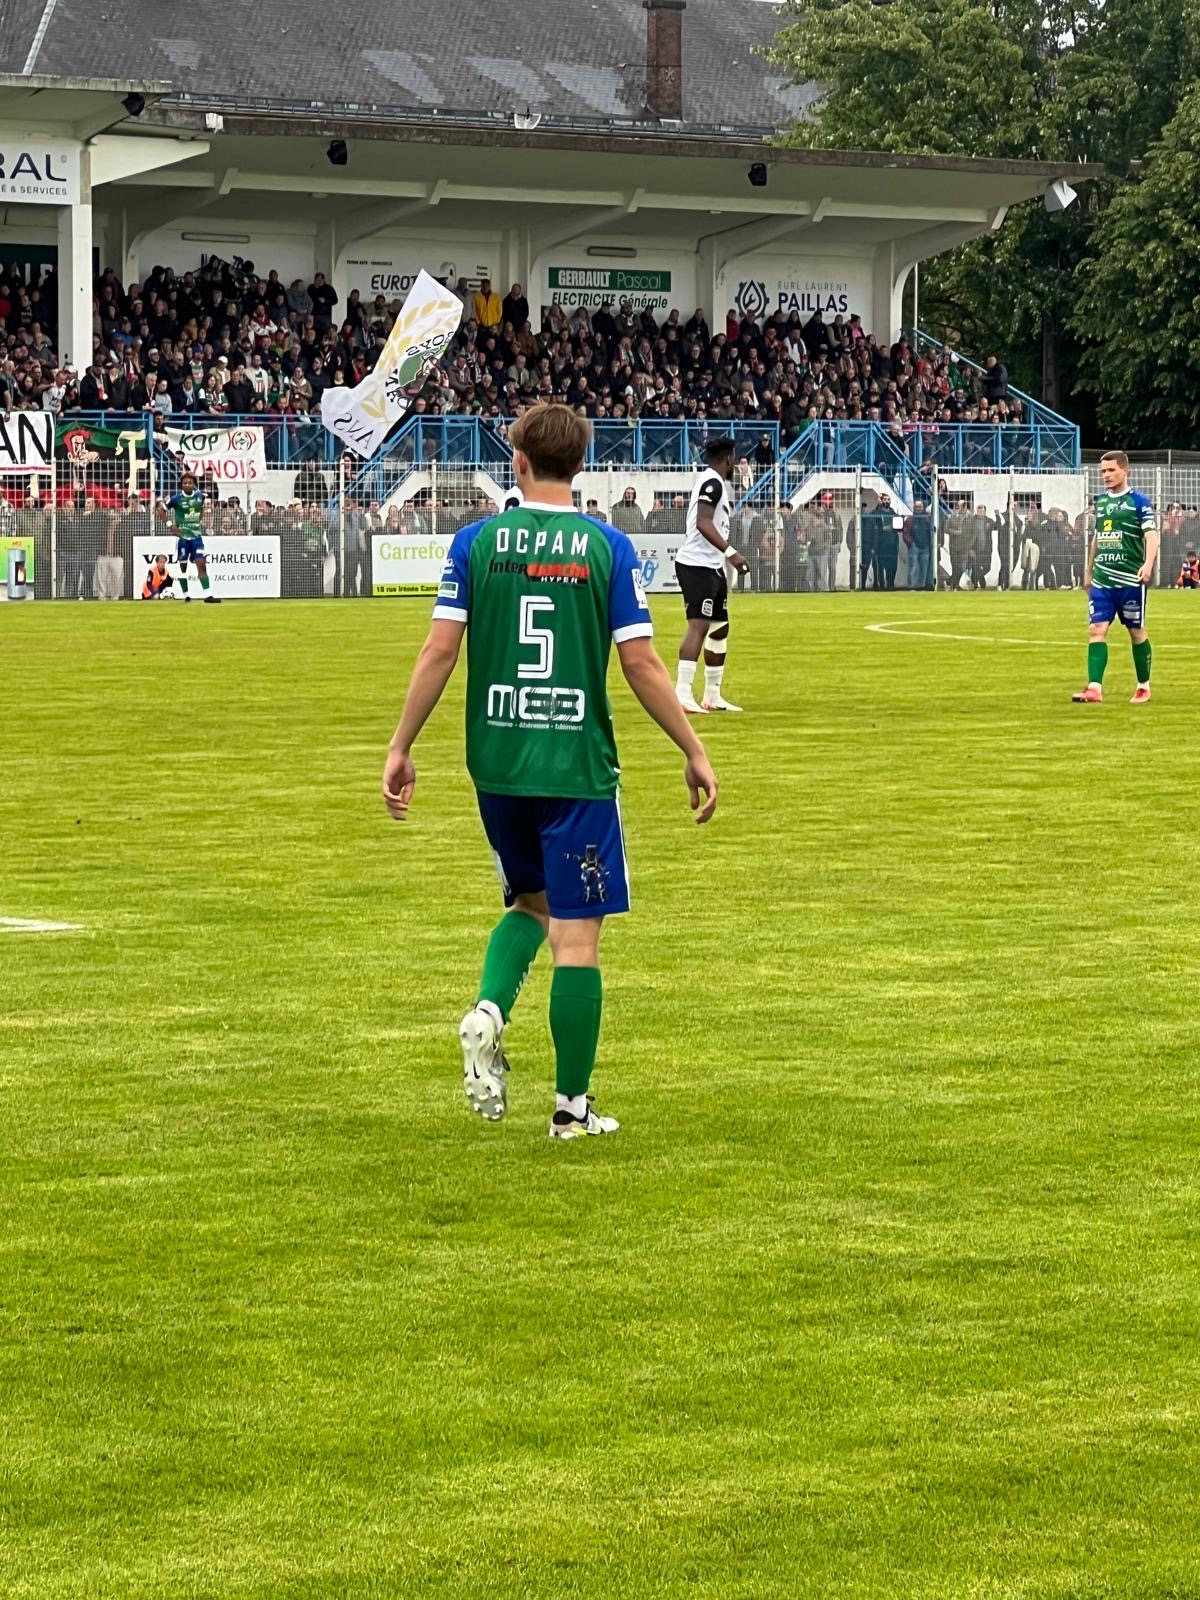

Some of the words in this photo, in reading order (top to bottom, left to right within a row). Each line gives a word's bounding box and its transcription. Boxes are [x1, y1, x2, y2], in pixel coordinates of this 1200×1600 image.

[20, 185, 67, 195] SERVICES
[558, 269, 611, 288] GERBAULT
[616, 271, 661, 289] Pascal
[777, 280, 800, 291] EURL
[805, 281, 848, 292] LAURENT
[618, 292, 669, 309] Générale
[778, 292, 848, 313] PAILLAS
[179, 433, 219, 452] KOP
[205, 553, 273, 564] CHARLEVILLE
[214, 574, 226, 582] ZAC
[227, 574, 236, 582] LA
[236, 574, 269, 582] CROISETTE
[540, 575, 578, 584] HYPER
[517, 595, 555, 679] 5
